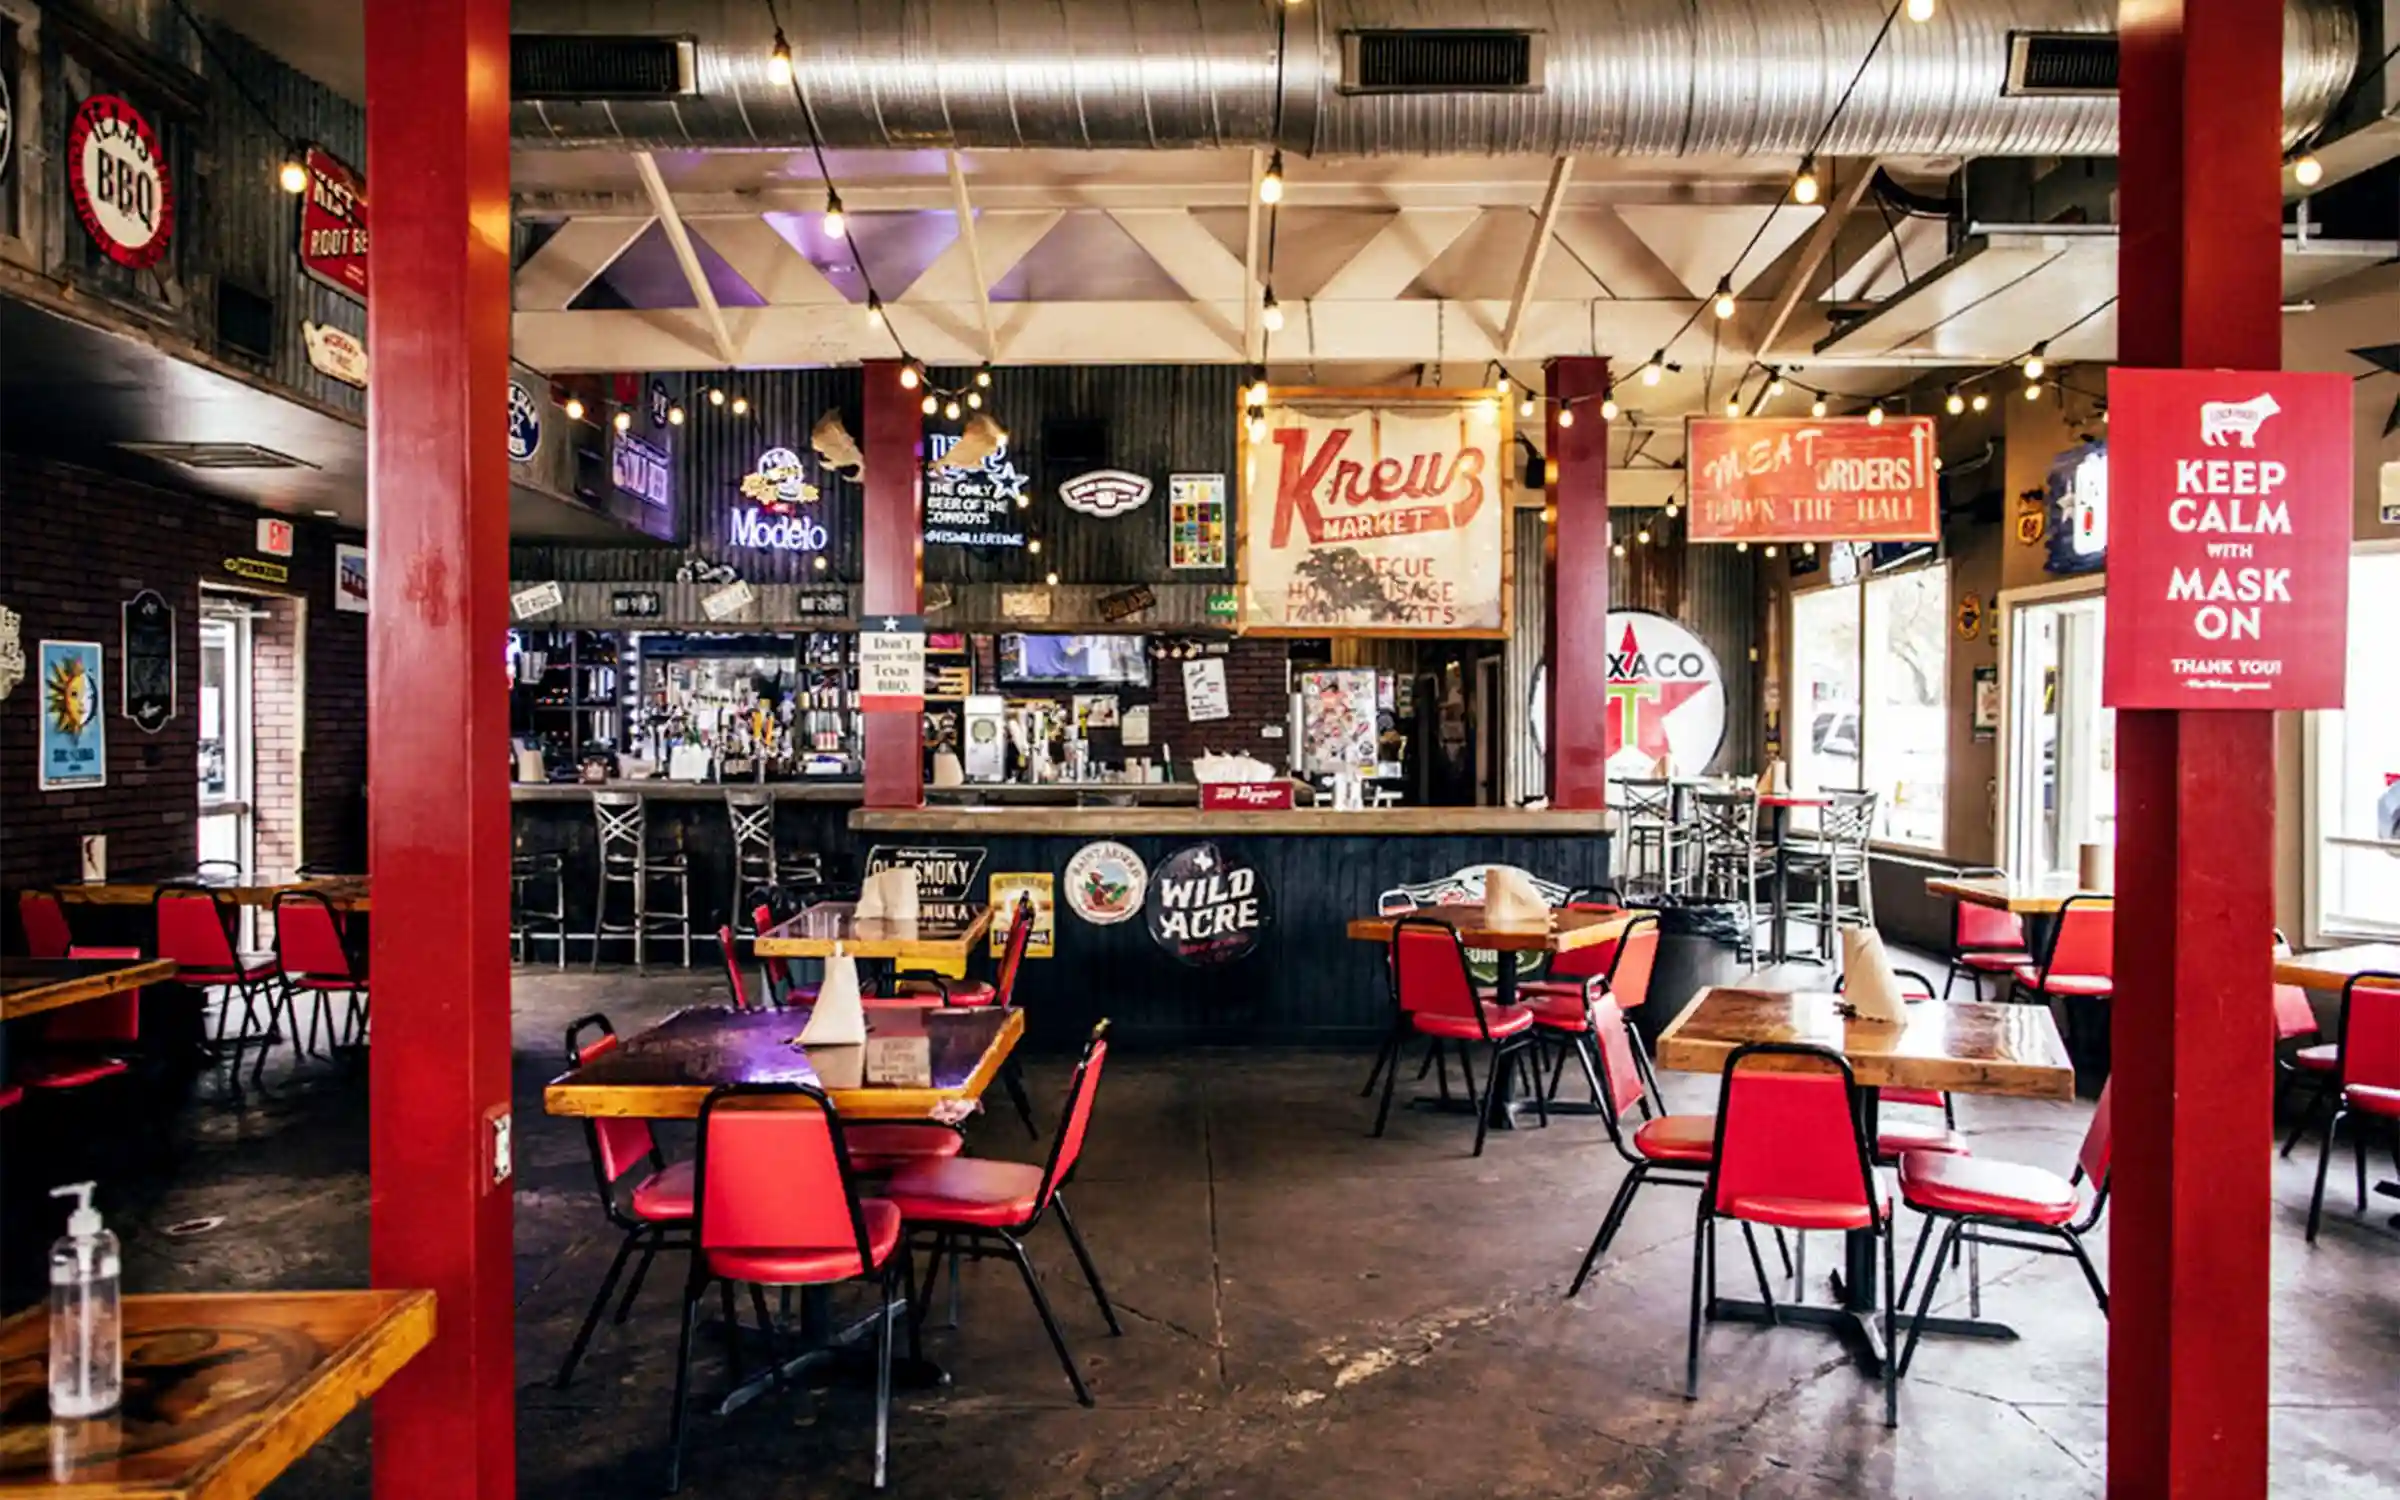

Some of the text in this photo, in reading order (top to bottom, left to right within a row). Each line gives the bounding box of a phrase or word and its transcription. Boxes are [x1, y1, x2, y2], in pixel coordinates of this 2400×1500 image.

[83, 103, 150, 162] TEXAS
[97, 148, 153, 233] BBQ
[310, 229, 368, 257] ROOT BE
[1704, 429, 1823, 490] MEAT
[1815, 458, 1912, 491] ORDERS
[929, 482, 993, 497] THE ONLY
[2176, 459, 2286, 495] KEEP
[927, 496, 1009, 513] BEER OF THE
[927, 511, 991, 524] COWBOYS
[1789, 496, 1833, 521] THE
[2168, 499, 2293, 535] CALM
[730, 508, 828, 550] Modelo
[1322, 509, 1432, 541] MARKET
[2206, 543, 2254, 559] WITH
[2166, 566, 2293, 602] MASK
[2194, 605, 2262, 640] ON
[863, 651, 922, 662] mess with
[873, 637, 911, 649] Don't
[873, 665, 910, 676] Texas
[1606, 652, 1705, 678] XACO
[2171, 659, 2283, 675] THANK YOU!
[912, 860, 970, 885] SMOKY
[1161, 867, 1254, 909] WILD
[1159, 898, 1259, 940] ACRE
